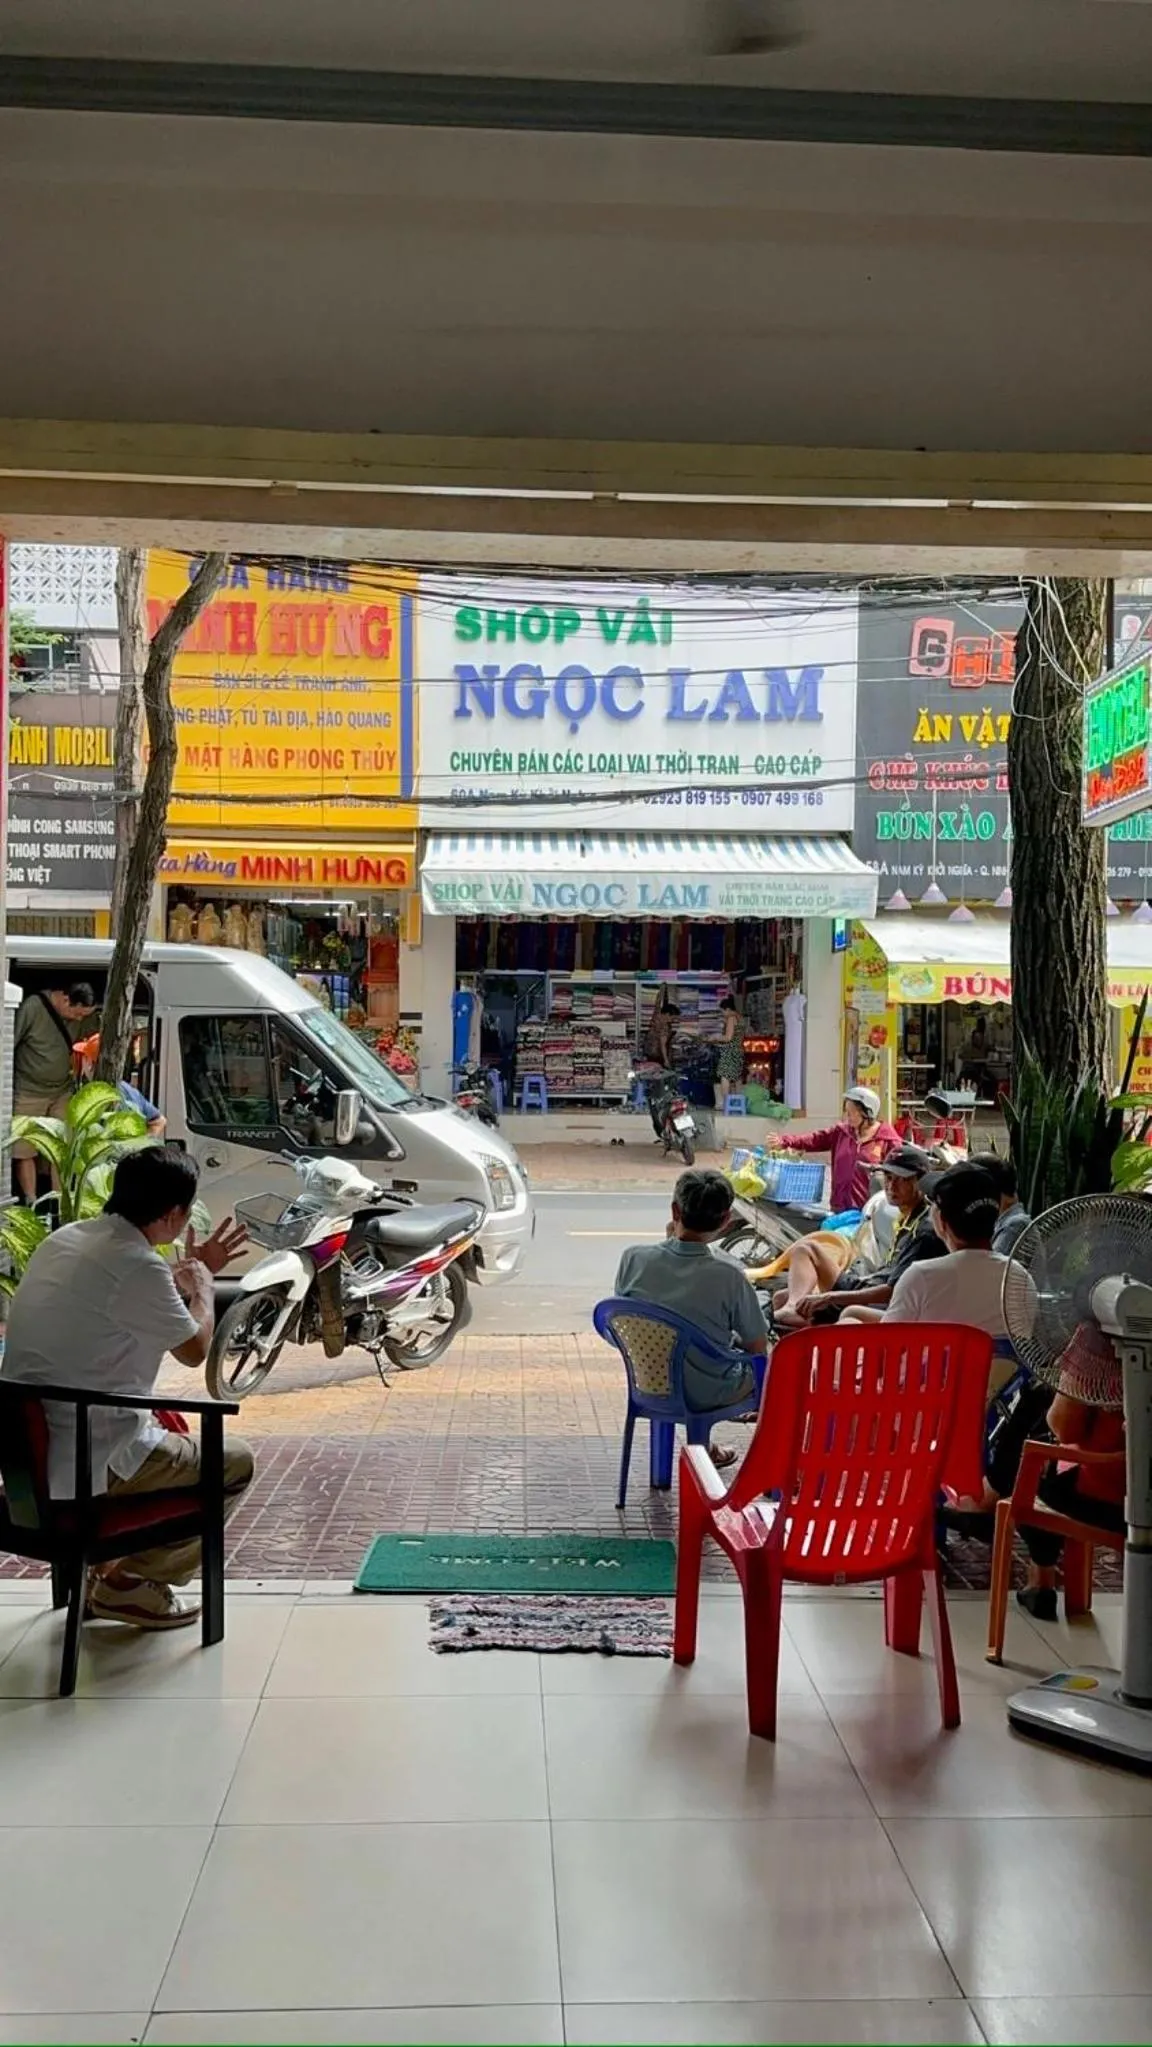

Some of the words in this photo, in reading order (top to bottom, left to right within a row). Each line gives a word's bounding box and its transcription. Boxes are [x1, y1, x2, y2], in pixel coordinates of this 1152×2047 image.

[454, 606, 582, 644] SHOP
[596, 596, 674, 645] VẢI
[453, 662, 646, 734] NGỌC
[665, 668, 824, 722] LAM
[347, 710, 392, 730] QUANG
[912, 707, 953, 742] ĂN
[54, 726, 116, 766] MOBIL
[184, 741, 224, 772] MẶT
[228, 743, 280, 769] HÀNG
[283, 748, 345, 770] PHONG
[351, 741, 397, 772] THỦY
[450, 747, 513, 773] CHUYÊN
[517, 747, 549, 774] BÁN
[552, 748, 584, 774] CÁC
[588, 753, 623, 778] LOẠI
[655, 749, 694, 775] THỜI
[754, 754, 787, 776] CAO
[685, 791, 707, 805] 819
[709, 791, 732, 806] 155
[741, 791, 772, 806] 0907
[777, 791, 801, 806] 499
[803, 792, 824, 806] 168
[65, 819, 115, 835] SAMSUNG
[876, 803, 933, 840] BÚN
[937, 803, 996, 841] XÀO
[43, 844, 82, 859] SMART
[241, 855, 314, 881] MINH
[322, 855, 407, 885] HƯNG
[891, 865, 912, 875] NAM
[432, 882, 483, 900] SHOP
[637, 883, 710, 910] LAM
[943, 972, 1012, 997] BÚN
[226, 1130, 280, 1140] TRANSIT
